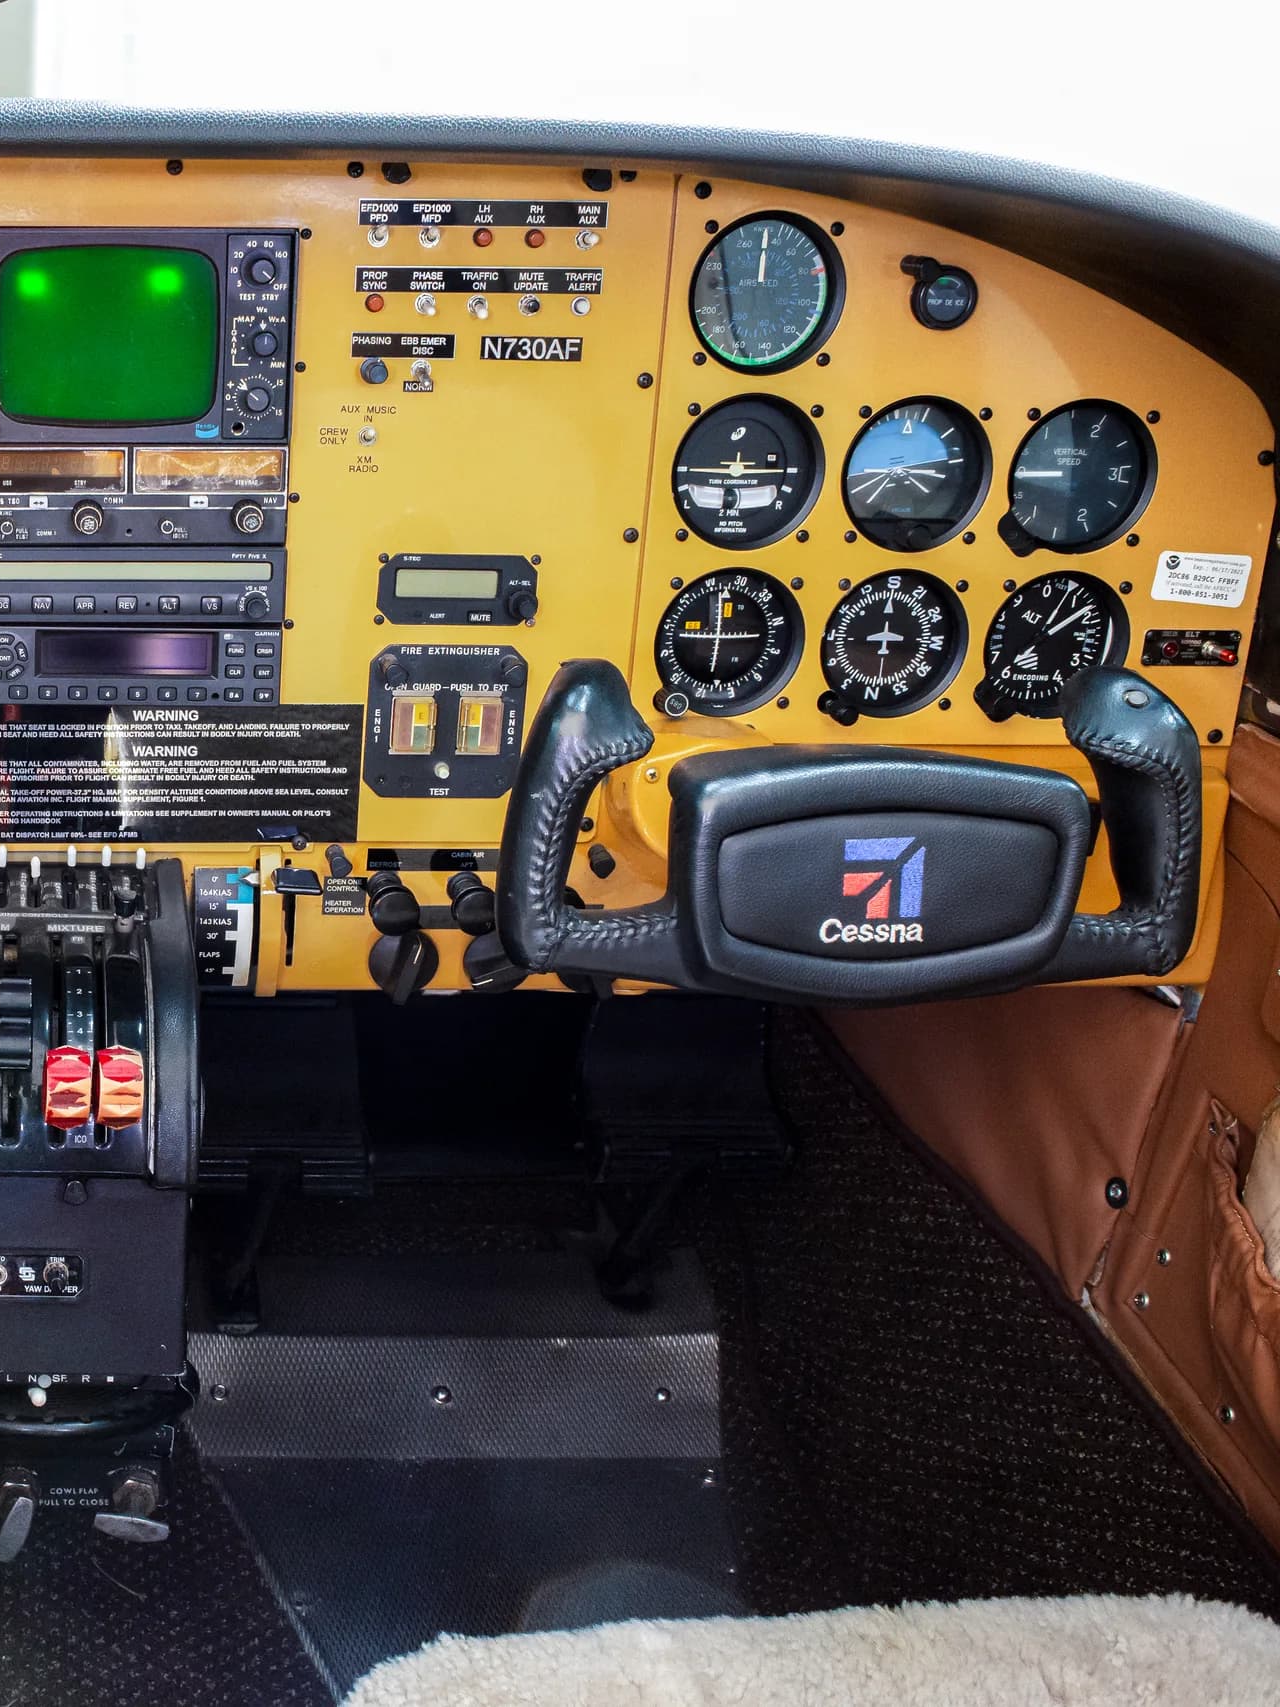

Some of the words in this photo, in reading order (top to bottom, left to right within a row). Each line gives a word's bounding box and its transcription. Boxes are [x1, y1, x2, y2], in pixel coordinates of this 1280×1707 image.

[361, 203, 399, 213] EFD1000
[413, 203, 451, 213] EFD1000
[478, 204, 491, 214] LH
[530, 205, 543, 214] RH
[578, 205, 601, 215] MAIN
[370, 213, 388, 223] PFD
[421, 213, 442, 223] MFD
[474, 214, 493, 224] AUX
[526, 215, 546, 224] AUX
[578, 215, 599, 225] AUX
[246, 240, 258, 248] 40
[263, 240, 274, 248] 80
[233, 251, 244, 259] 20
[230, 266, 238, 274] 10
[362, 271, 388, 281] PROP
[412, 271, 443, 281] PHASE
[461, 271, 499, 281] TRAFFIC
[519, 272, 544, 281] MUTE
[565, 272, 602, 282] TRAFFIC
[273, 283, 287, 291] OFF
[362, 280, 387, 290] SYNC
[410, 280, 445, 291] SWITCH
[472, 281, 487, 291] ON
[514, 281, 548, 291] UPDATE
[568, 282, 597, 292] ALERT
[239, 293, 256, 301] TEST
[261, 293, 279, 301] STBY
[352, 336, 392, 345] PHASING
[420, 336, 446, 346] EMER
[412, 346, 434, 355] DISC
[483, 337, 581, 361] N730AF
[270, 361, 285, 369] MIN
[340, 405, 361, 415] AUX
[366, 405, 397, 415] MUSIC
[363, 414, 373, 423] IN
[319, 427, 349, 436] CREW
[1090, 424, 1101, 438] 2
[319, 436, 347, 445] ONLY
[1053, 448, 1088, 457] VERTICAL
[356, 455, 372, 464] XM
[349, 464, 378, 473] RADIO
[1108, 467, 1118, 481] 3
[103, 496, 124, 505] COMM
[1077, 508, 1088, 522] 2
[734, 575, 748, 587] 30
[887, 575, 902, 589] S
[758, 588, 773, 602] 33
[1042, 584, 1052, 598] 0
[76, 602, 94, 610] APR
[119, 602, 136, 610] REV
[162, 602, 177, 610] ALT
[470, 614, 491, 622] MUTE
[927, 606, 943, 623] 24
[1021, 609, 1042, 625] ALT
[401, 646, 423, 655] FIRE
[428, 647, 500, 656] EXTINGUISHER
[1070, 653, 1080, 667] 3
[1001, 665, 1011, 679] 6
[1012, 674, 1049, 682] ENCODING
[477, 683, 489, 691] TO
[493, 683, 509, 692] EXT
[892, 680, 909, 695] 33
[132, 710, 199, 722] WARNING
[132, 746, 199, 757] WARNING
[429, 788, 450, 796] TEST
[199, 888, 232, 897] 164KIAS
[326, 885, 360, 893] CONTROL
[199, 917, 232, 926] 143KIAS
[46, 923, 106, 933] MIXTURE
[819, 918, 924, 944] Cessna
[74, 1135, 87, 1144] ICO
[24, 1285, 42, 1293] YAW
